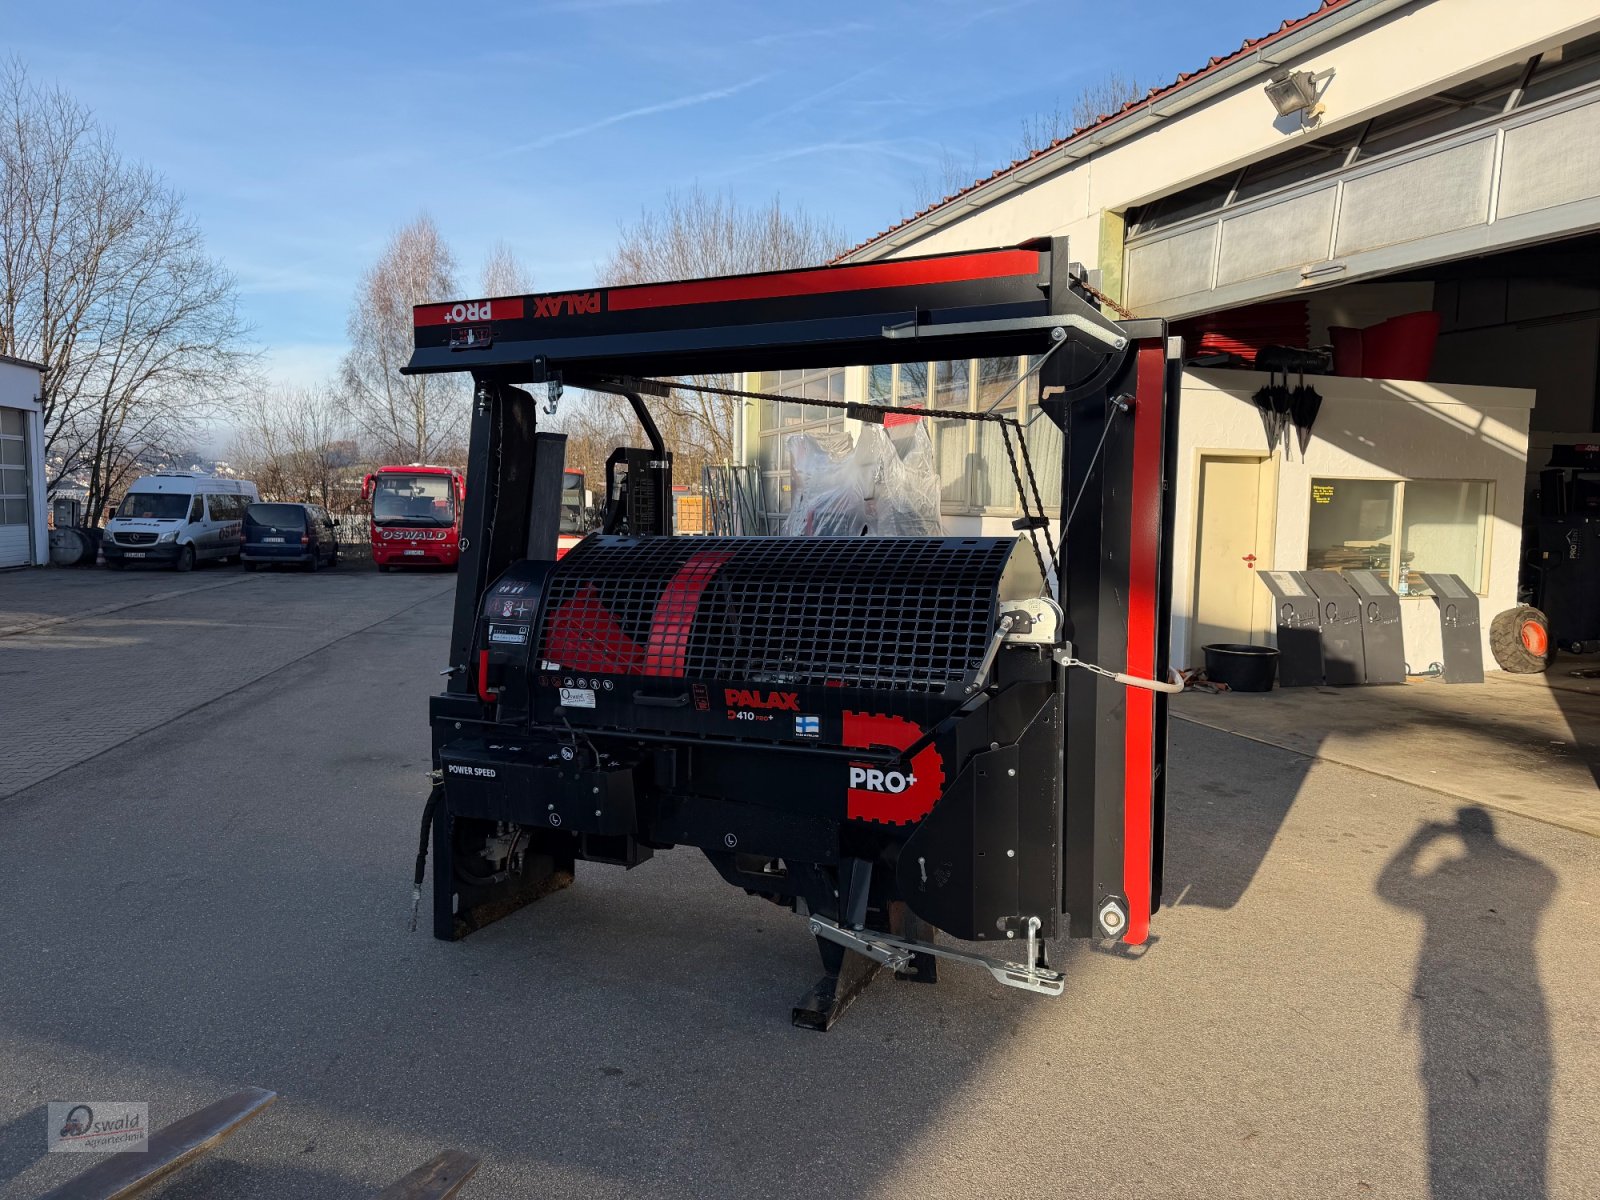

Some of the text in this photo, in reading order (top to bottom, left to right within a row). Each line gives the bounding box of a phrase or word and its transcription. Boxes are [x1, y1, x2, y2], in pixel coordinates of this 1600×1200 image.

[444, 293, 600, 322] PALAX PRO+
[382, 530, 447, 541] OSWALD
[725, 688, 800, 711] PALAX
[448, 765, 496, 777] POWER SPEED
[849, 766, 918, 793] PRO+
